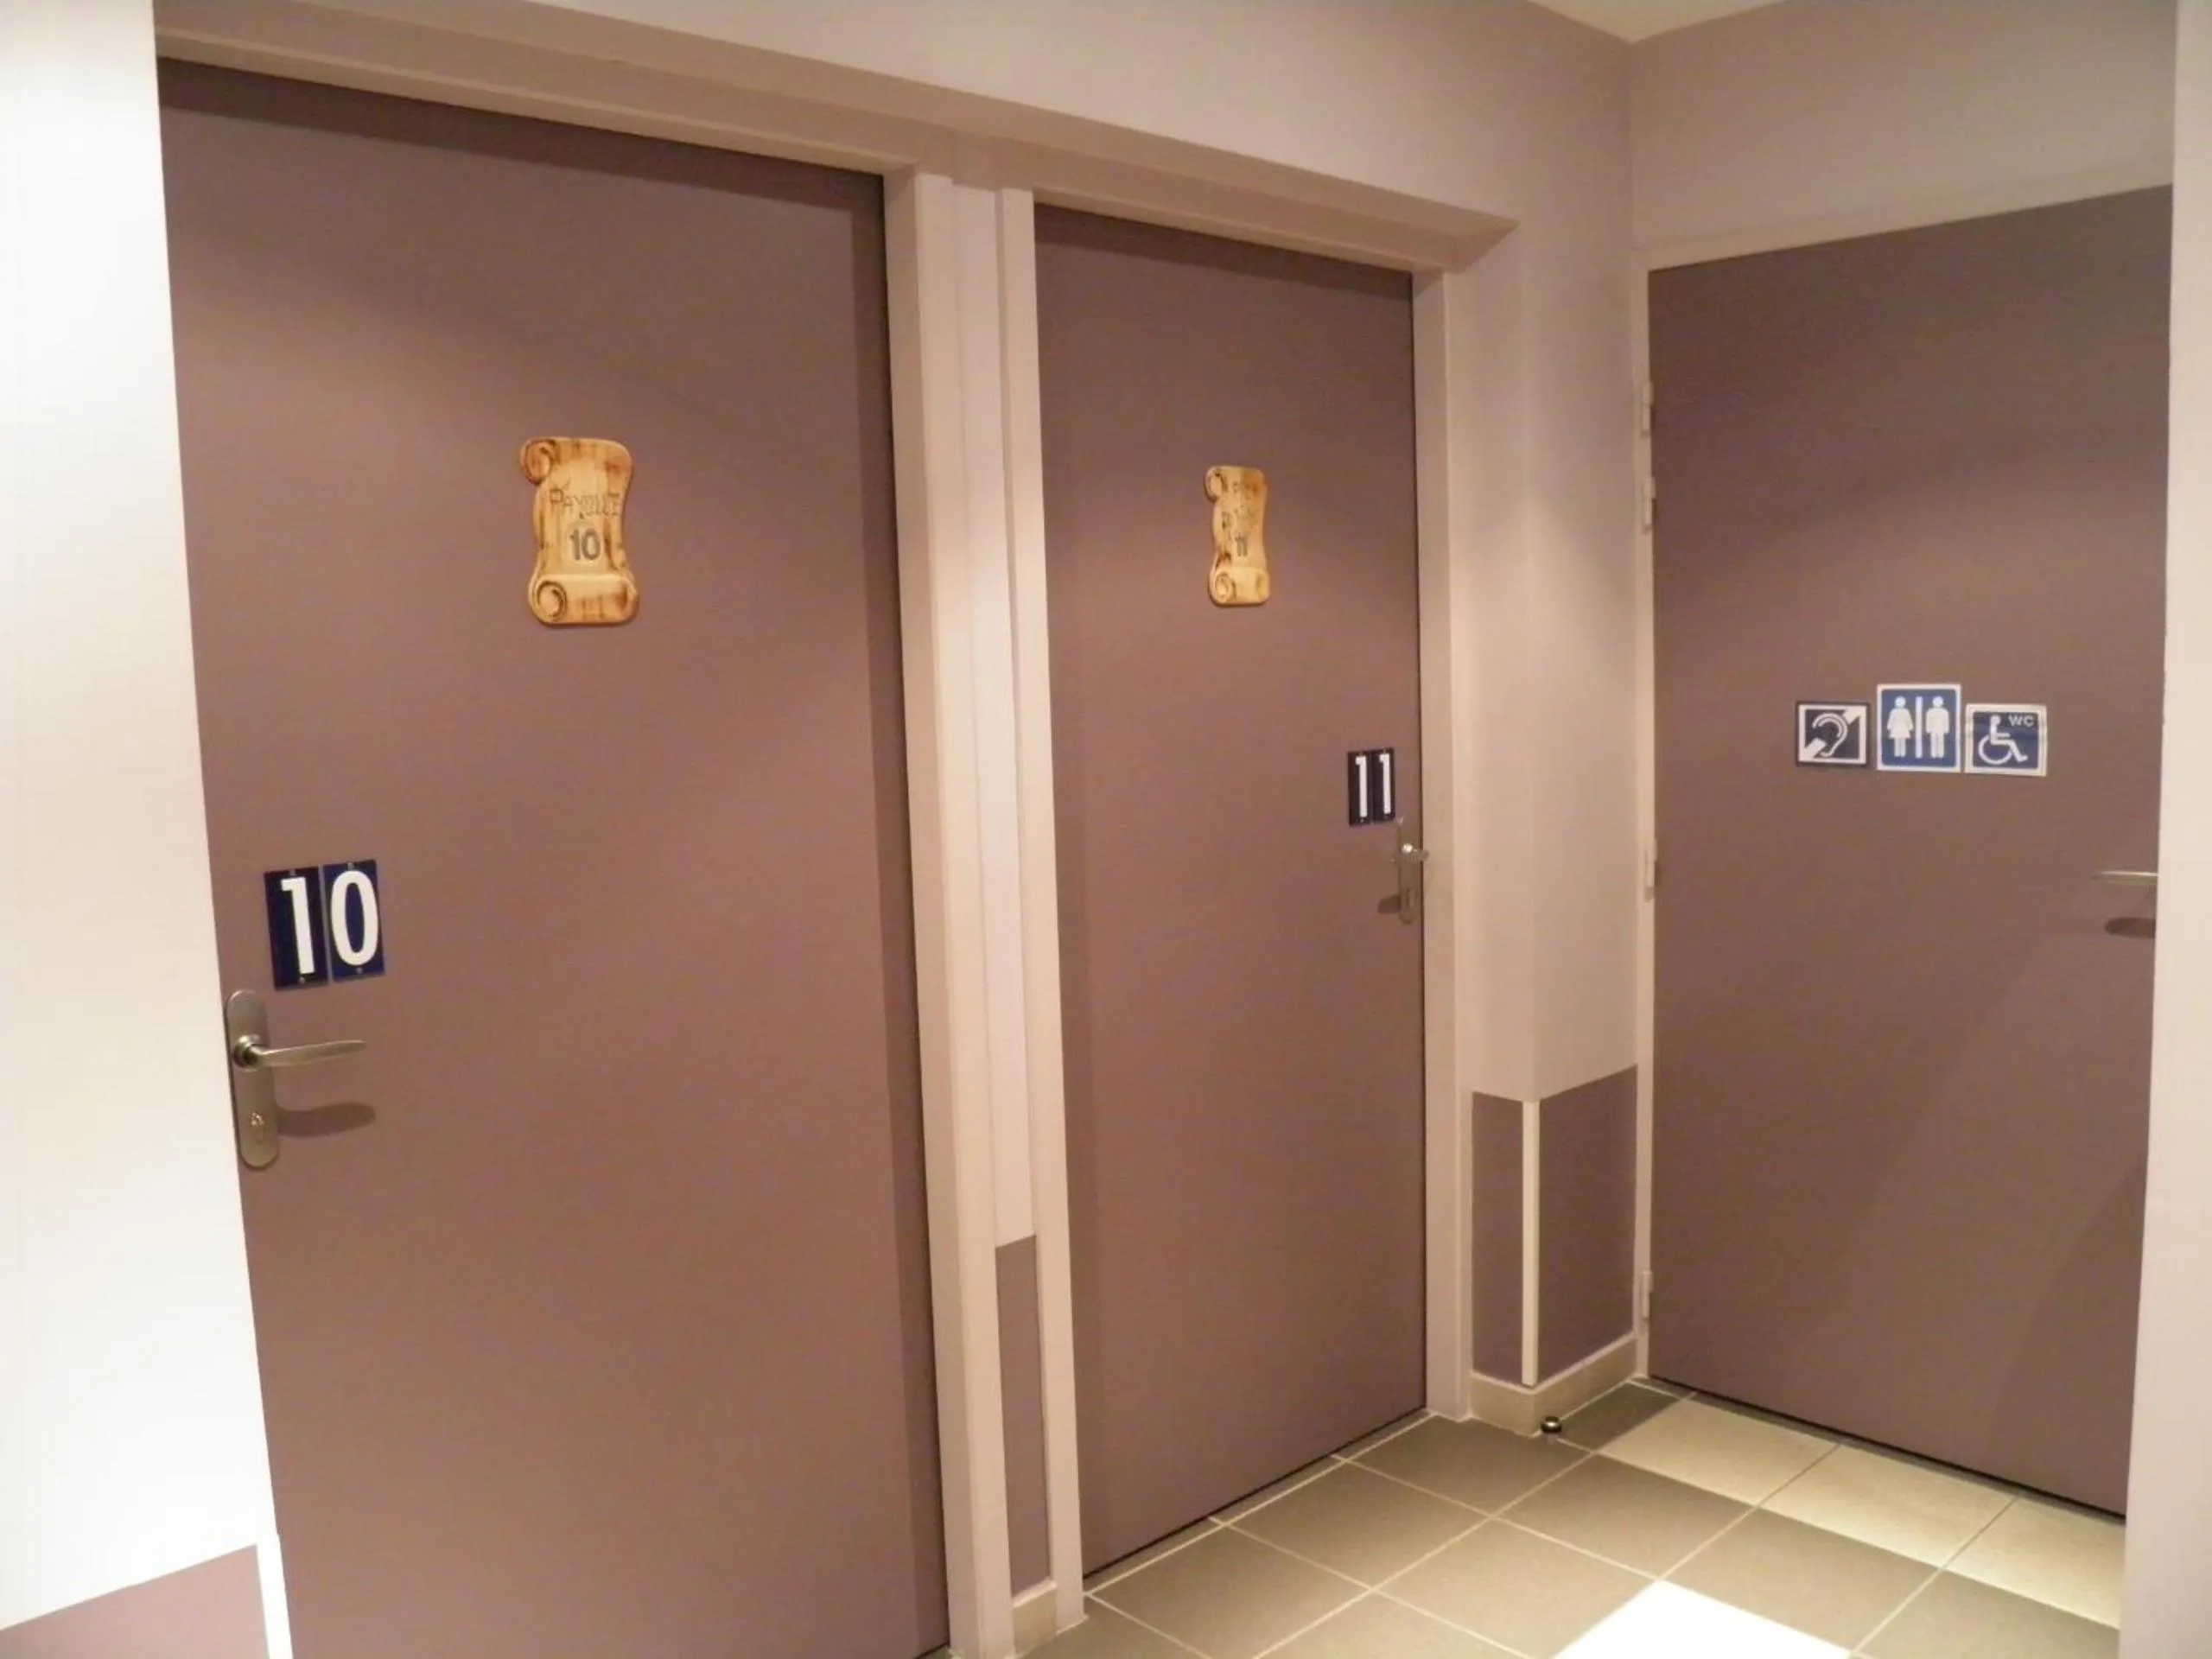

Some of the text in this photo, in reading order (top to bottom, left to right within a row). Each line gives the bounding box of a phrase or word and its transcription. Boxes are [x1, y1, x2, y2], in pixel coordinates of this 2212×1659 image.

[569, 527, 601, 562] 10
[2007, 714, 2034, 728] WC
[1355, 753, 1391, 818] 11
[280, 869, 378, 975] 10
